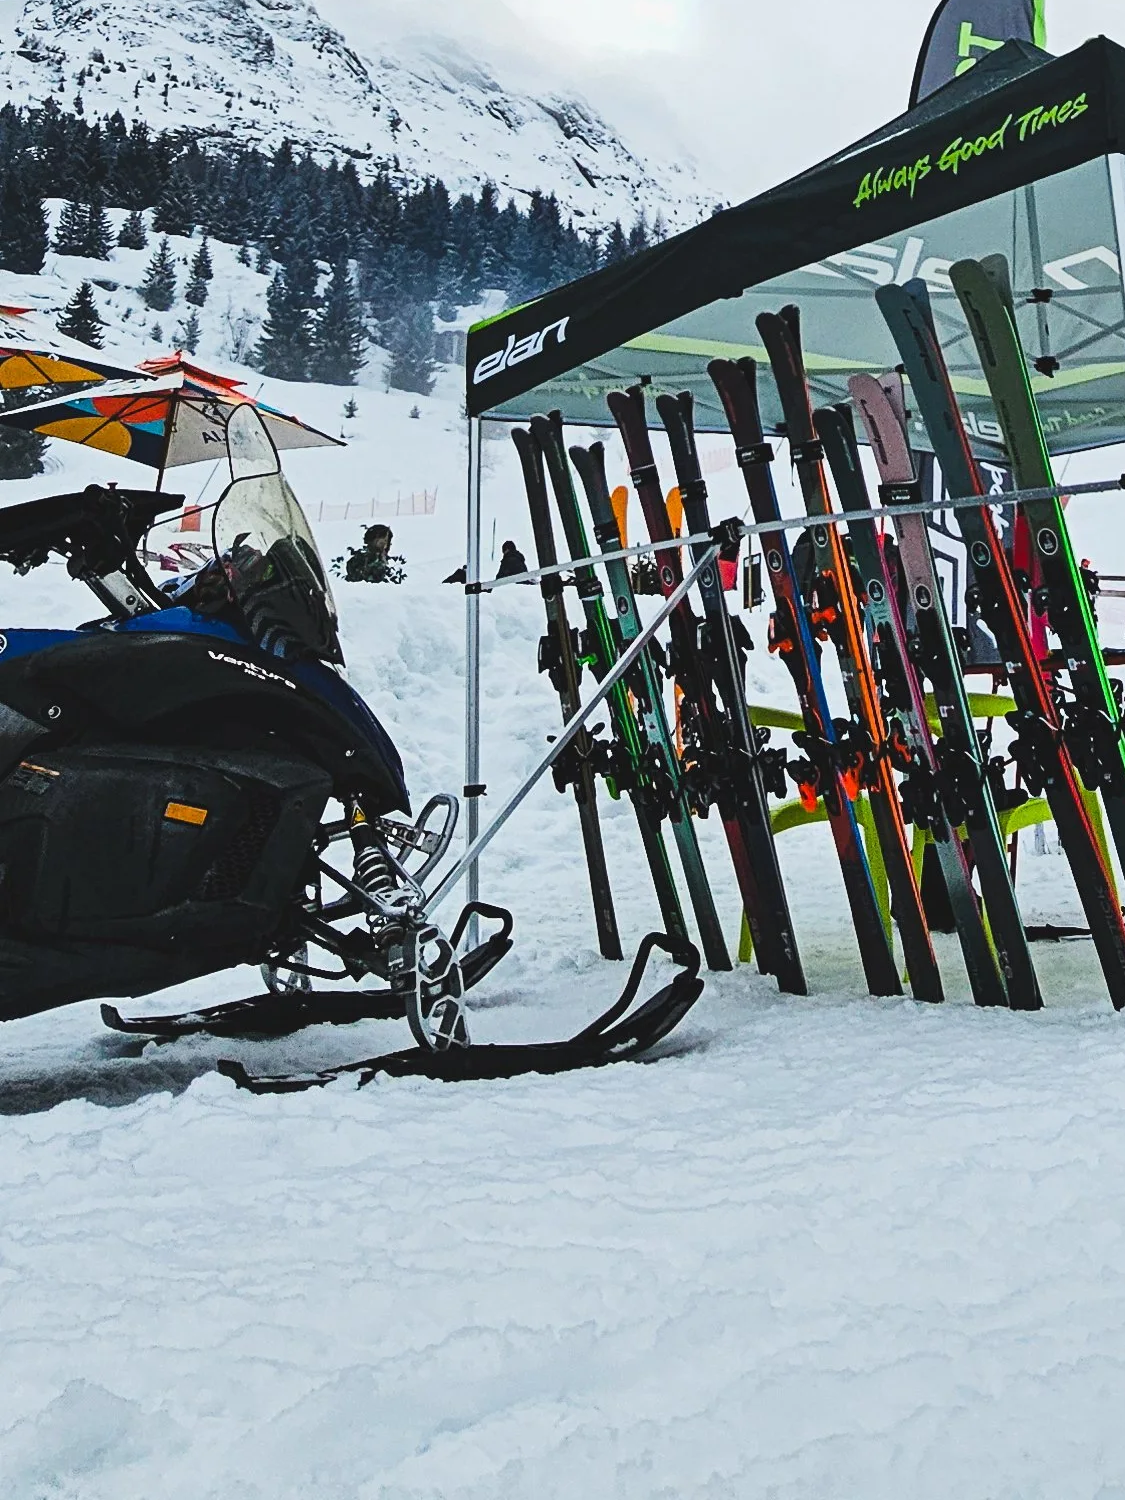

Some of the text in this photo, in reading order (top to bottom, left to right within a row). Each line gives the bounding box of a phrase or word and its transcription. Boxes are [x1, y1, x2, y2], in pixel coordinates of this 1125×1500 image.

[852, 92, 1088, 208] Always Good Times
[473, 316, 570, 385] elan
[208, 651, 296, 690] Venture
